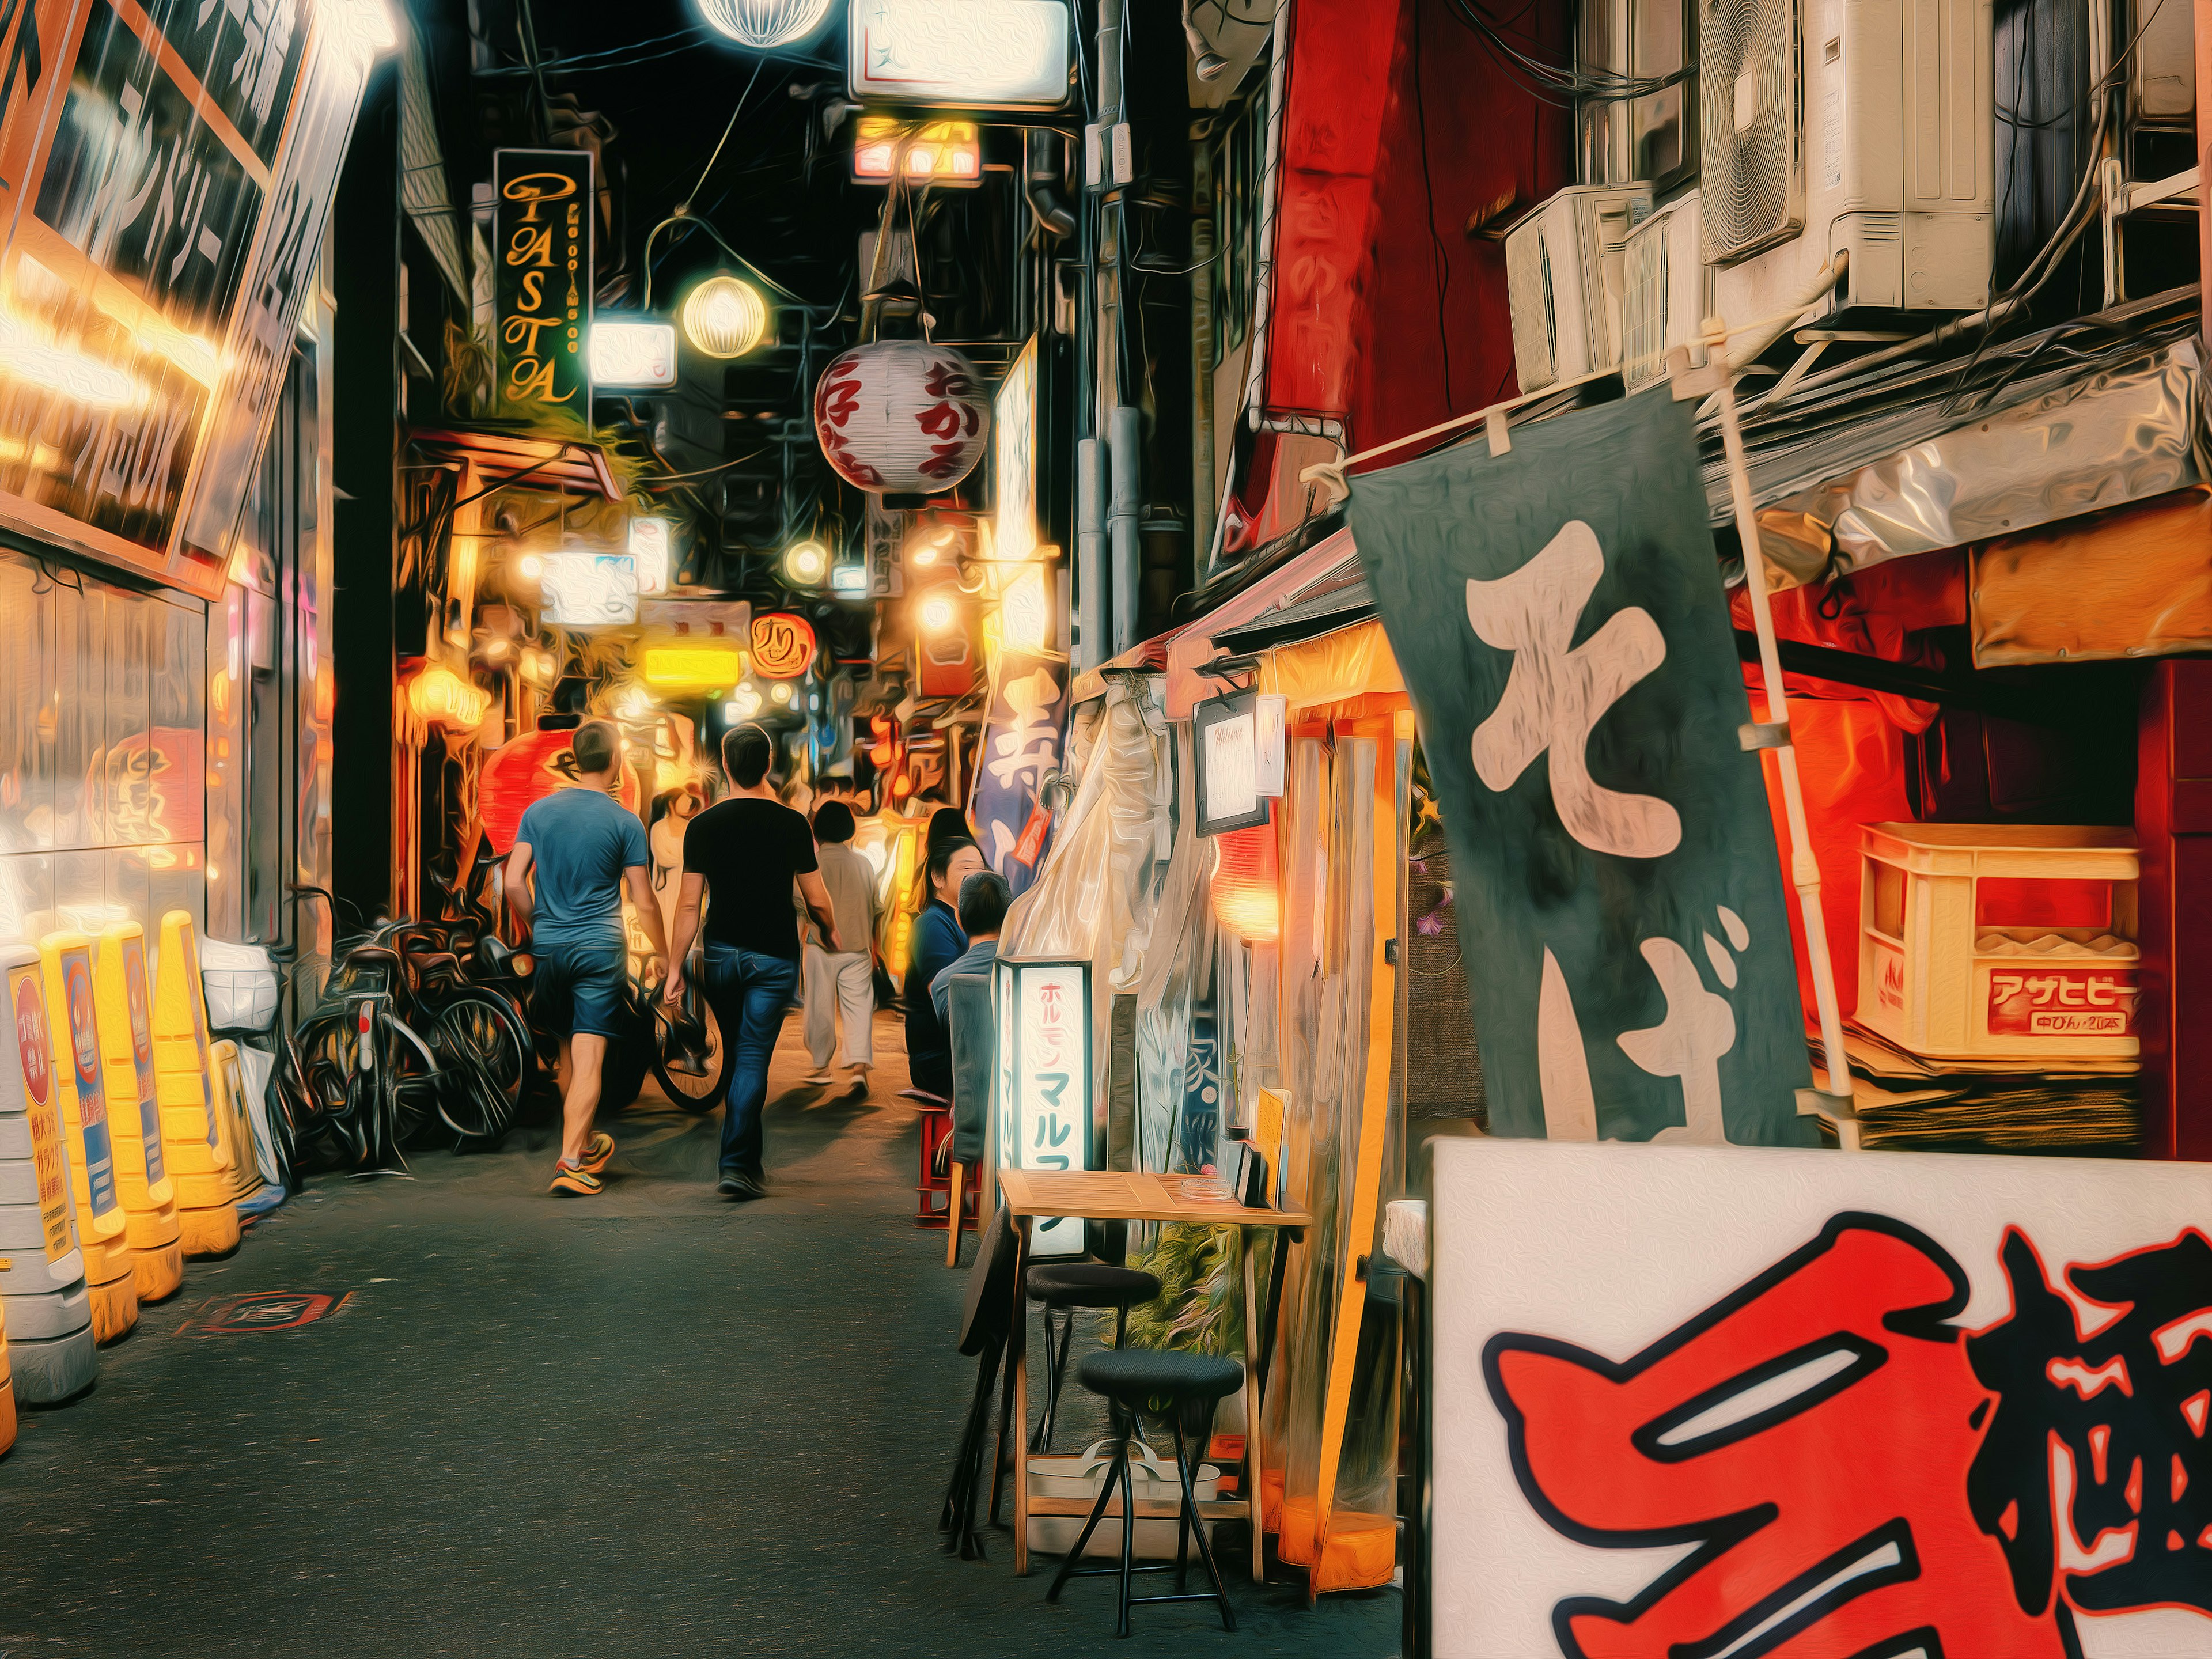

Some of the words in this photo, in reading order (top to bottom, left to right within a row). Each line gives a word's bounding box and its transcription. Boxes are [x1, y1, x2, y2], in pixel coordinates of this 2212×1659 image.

[502, 173, 578, 402] PASTA
[1214, 726, 1243, 747] Welcome
[1465, 520, 1749, 1143] そば
[1040, 982, 1062, 1067] ホルモン
[1993, 975, 2139, 1005] アサヒビー
